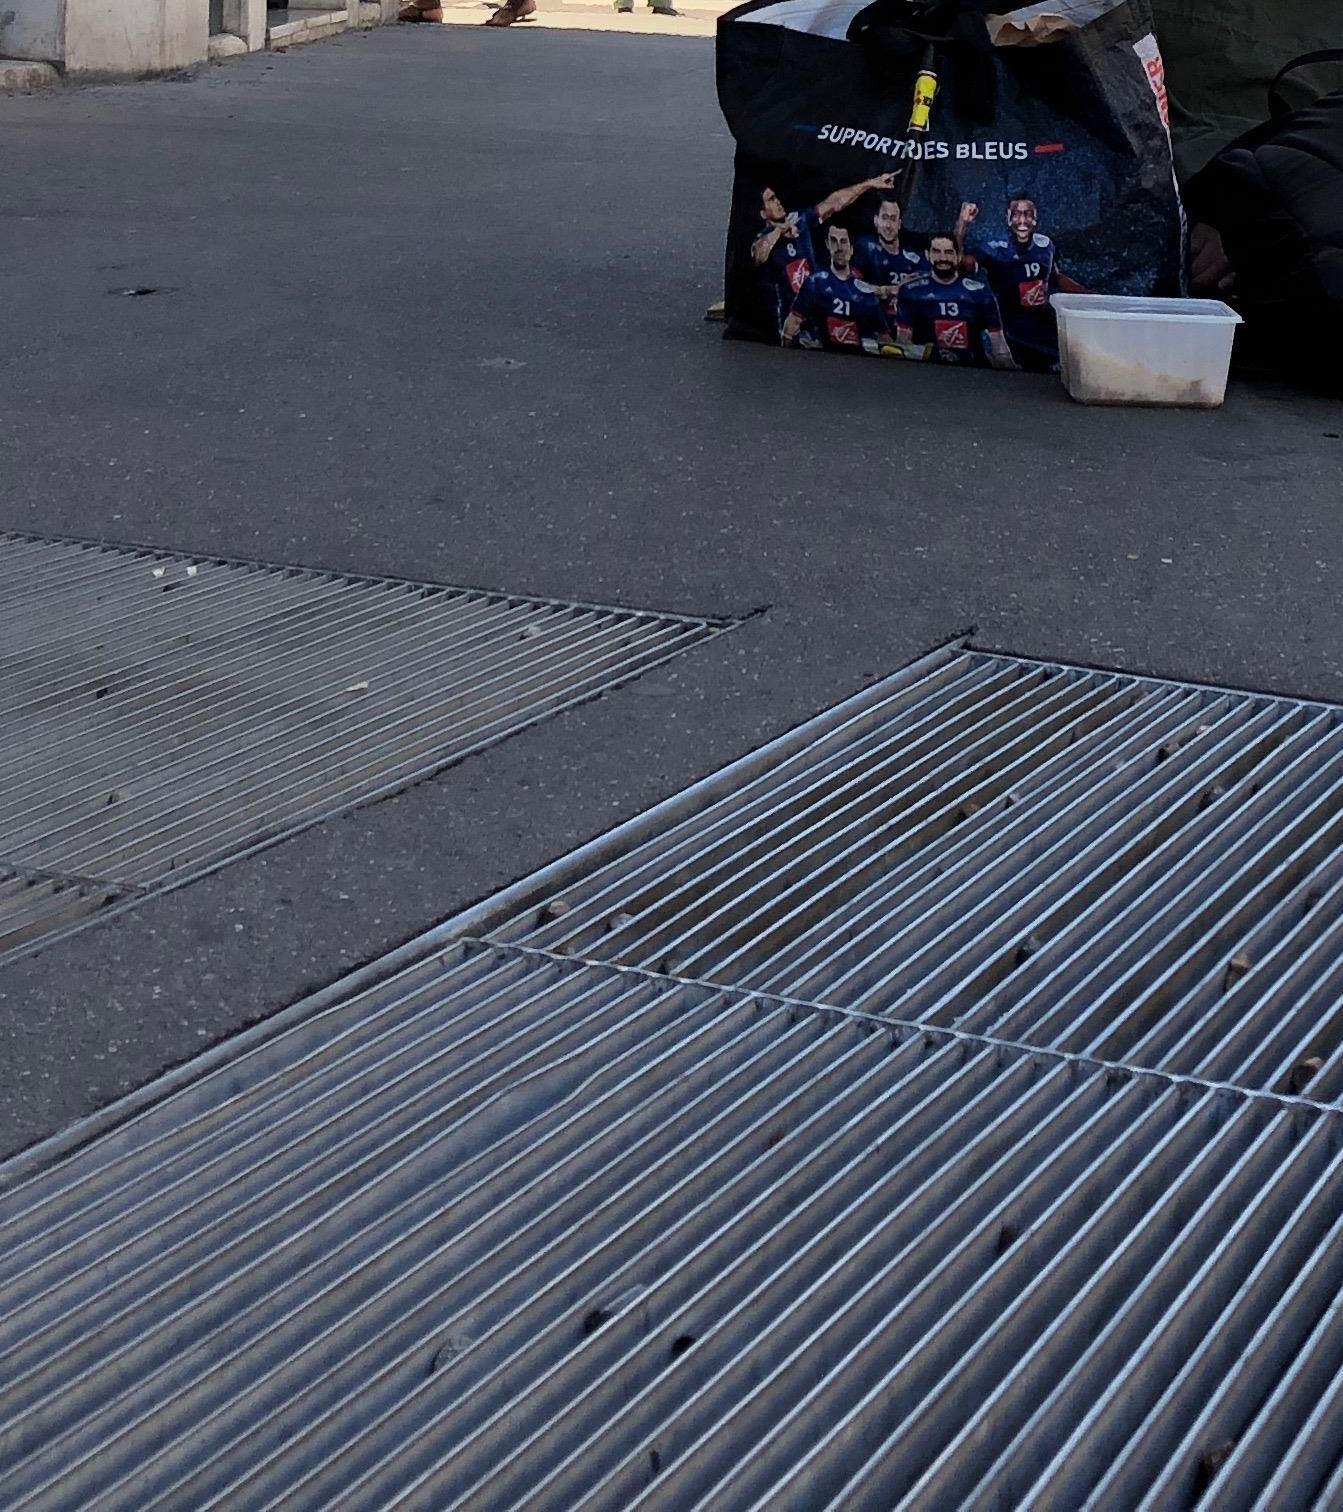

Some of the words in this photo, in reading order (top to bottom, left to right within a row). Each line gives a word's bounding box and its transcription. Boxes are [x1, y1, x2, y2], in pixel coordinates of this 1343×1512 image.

[955, 140, 1028, 160] BLEUS
[786, 243, 797, 257] 8
[1024, 262, 1041, 278] 19
[832, 297, 851, 316] 21
[938, 301, 960, 317] 13
